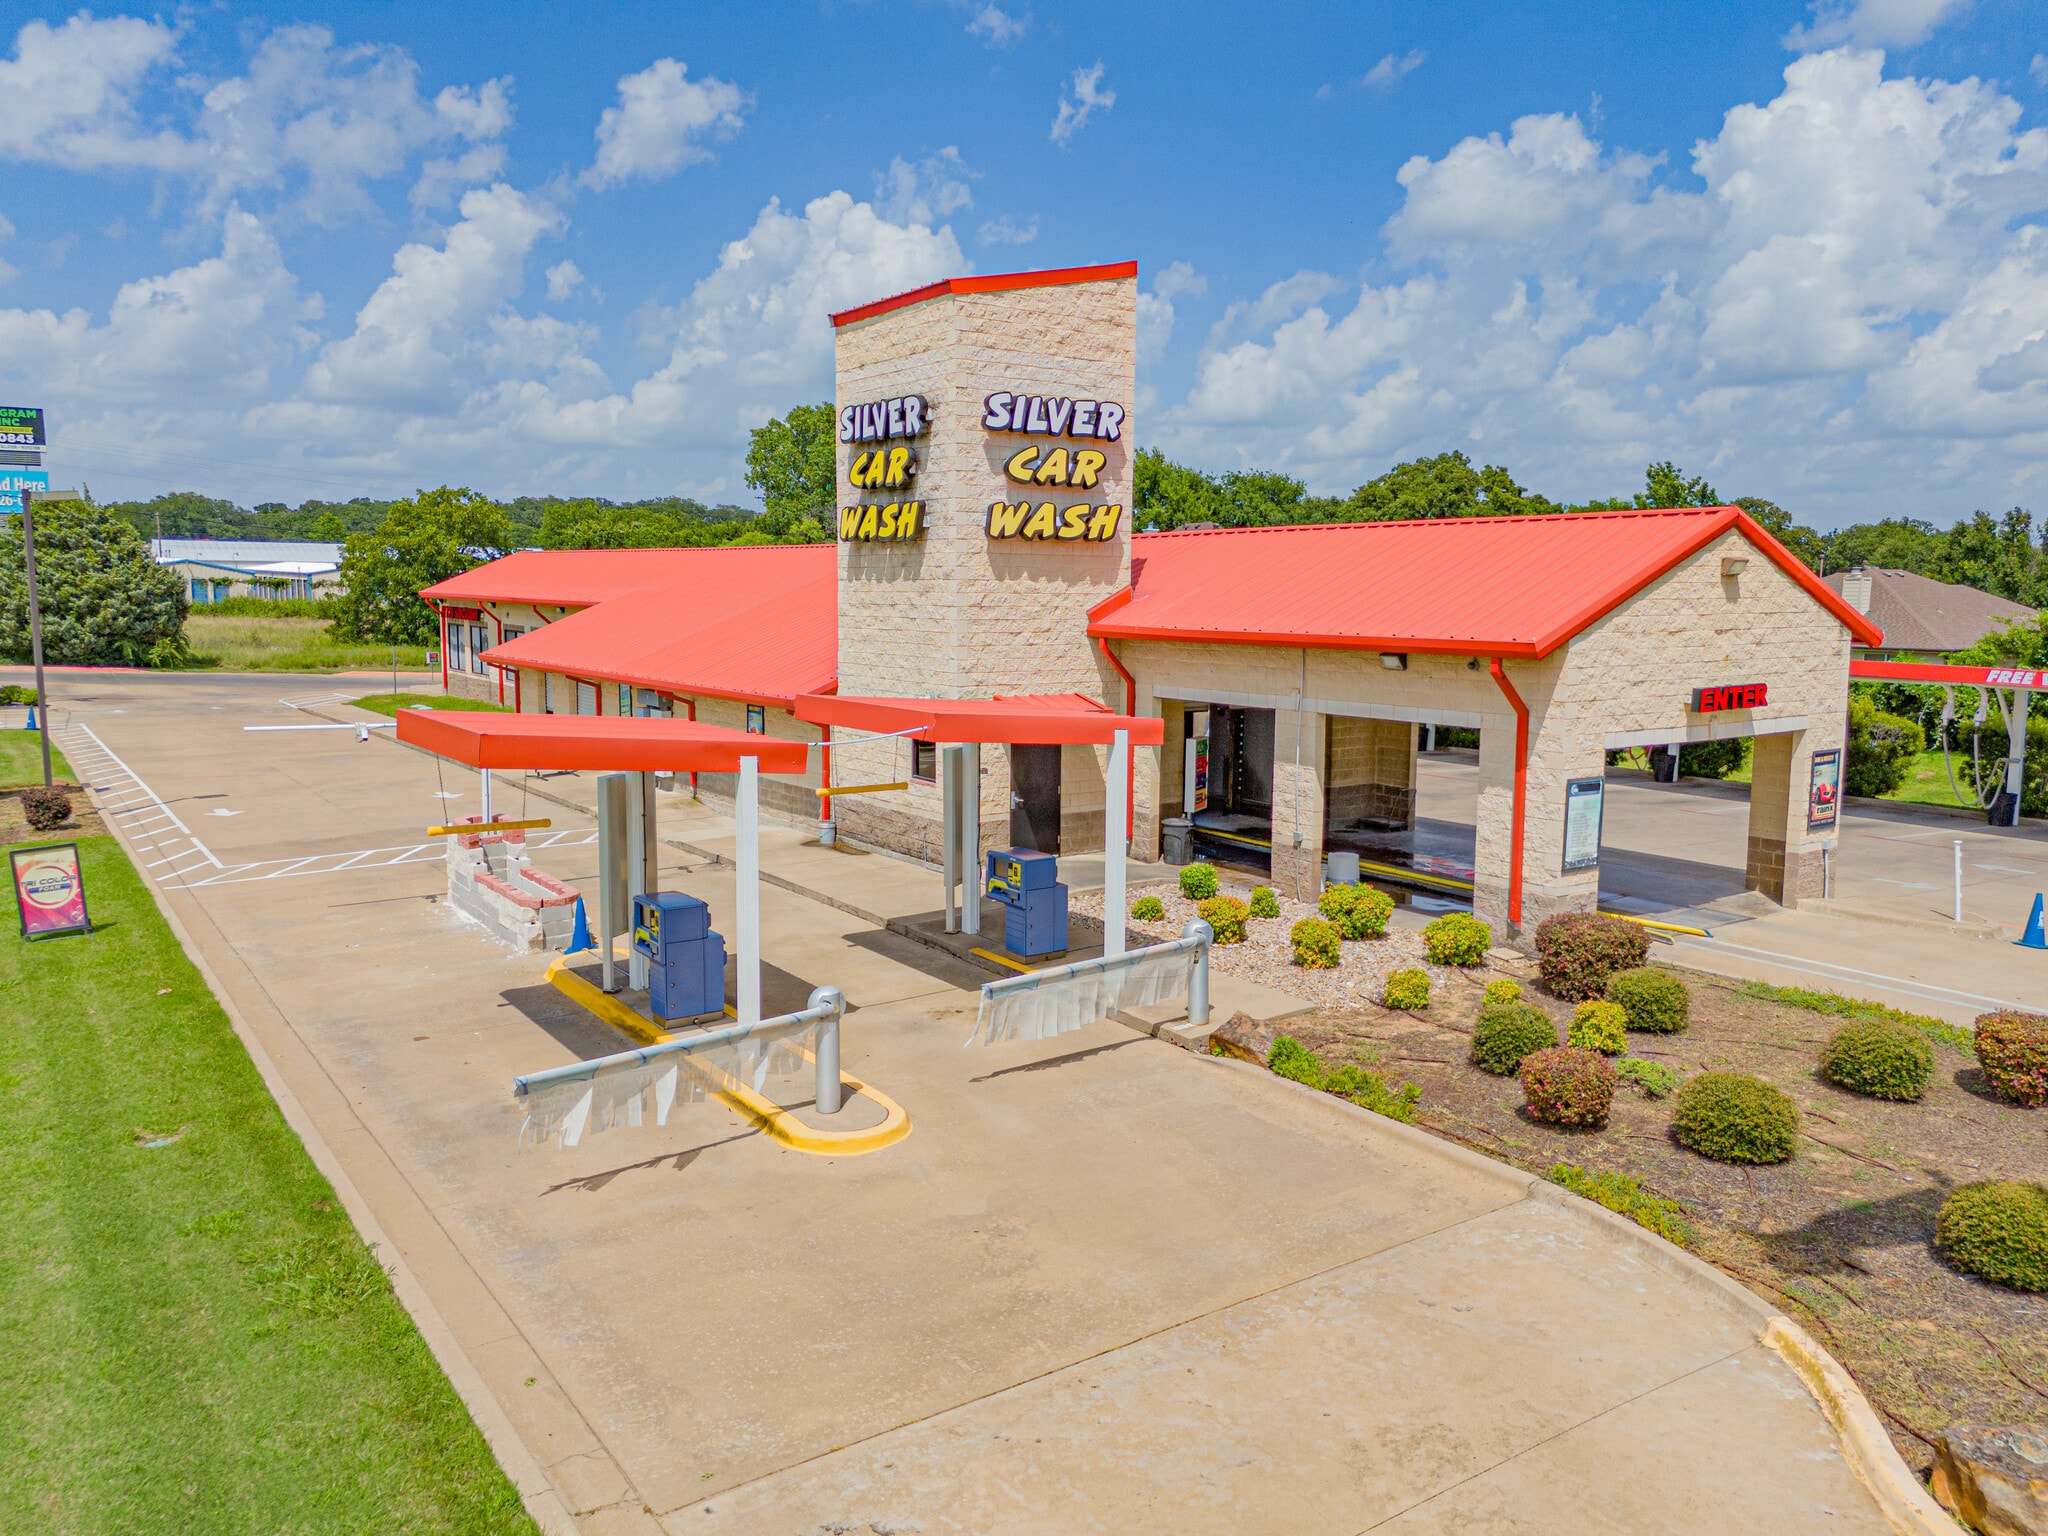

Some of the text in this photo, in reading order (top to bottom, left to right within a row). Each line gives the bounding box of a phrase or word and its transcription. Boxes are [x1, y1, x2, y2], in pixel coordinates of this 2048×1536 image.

[840, 395, 926, 443] SILVER
[983, 392, 1125, 442] SILVER
[0, 477, 46, 492] d Here
[849, 446, 912, 488] CAR
[1005, 445, 1107, 489] CAR
[840, 500, 924, 542] WASH
[986, 501, 1122, 542] WASH
[1698, 682, 1768, 713] ENTER
[1986, 669, 2036, 685] FREE
[20, 875, 76, 888] TRI COLOR
